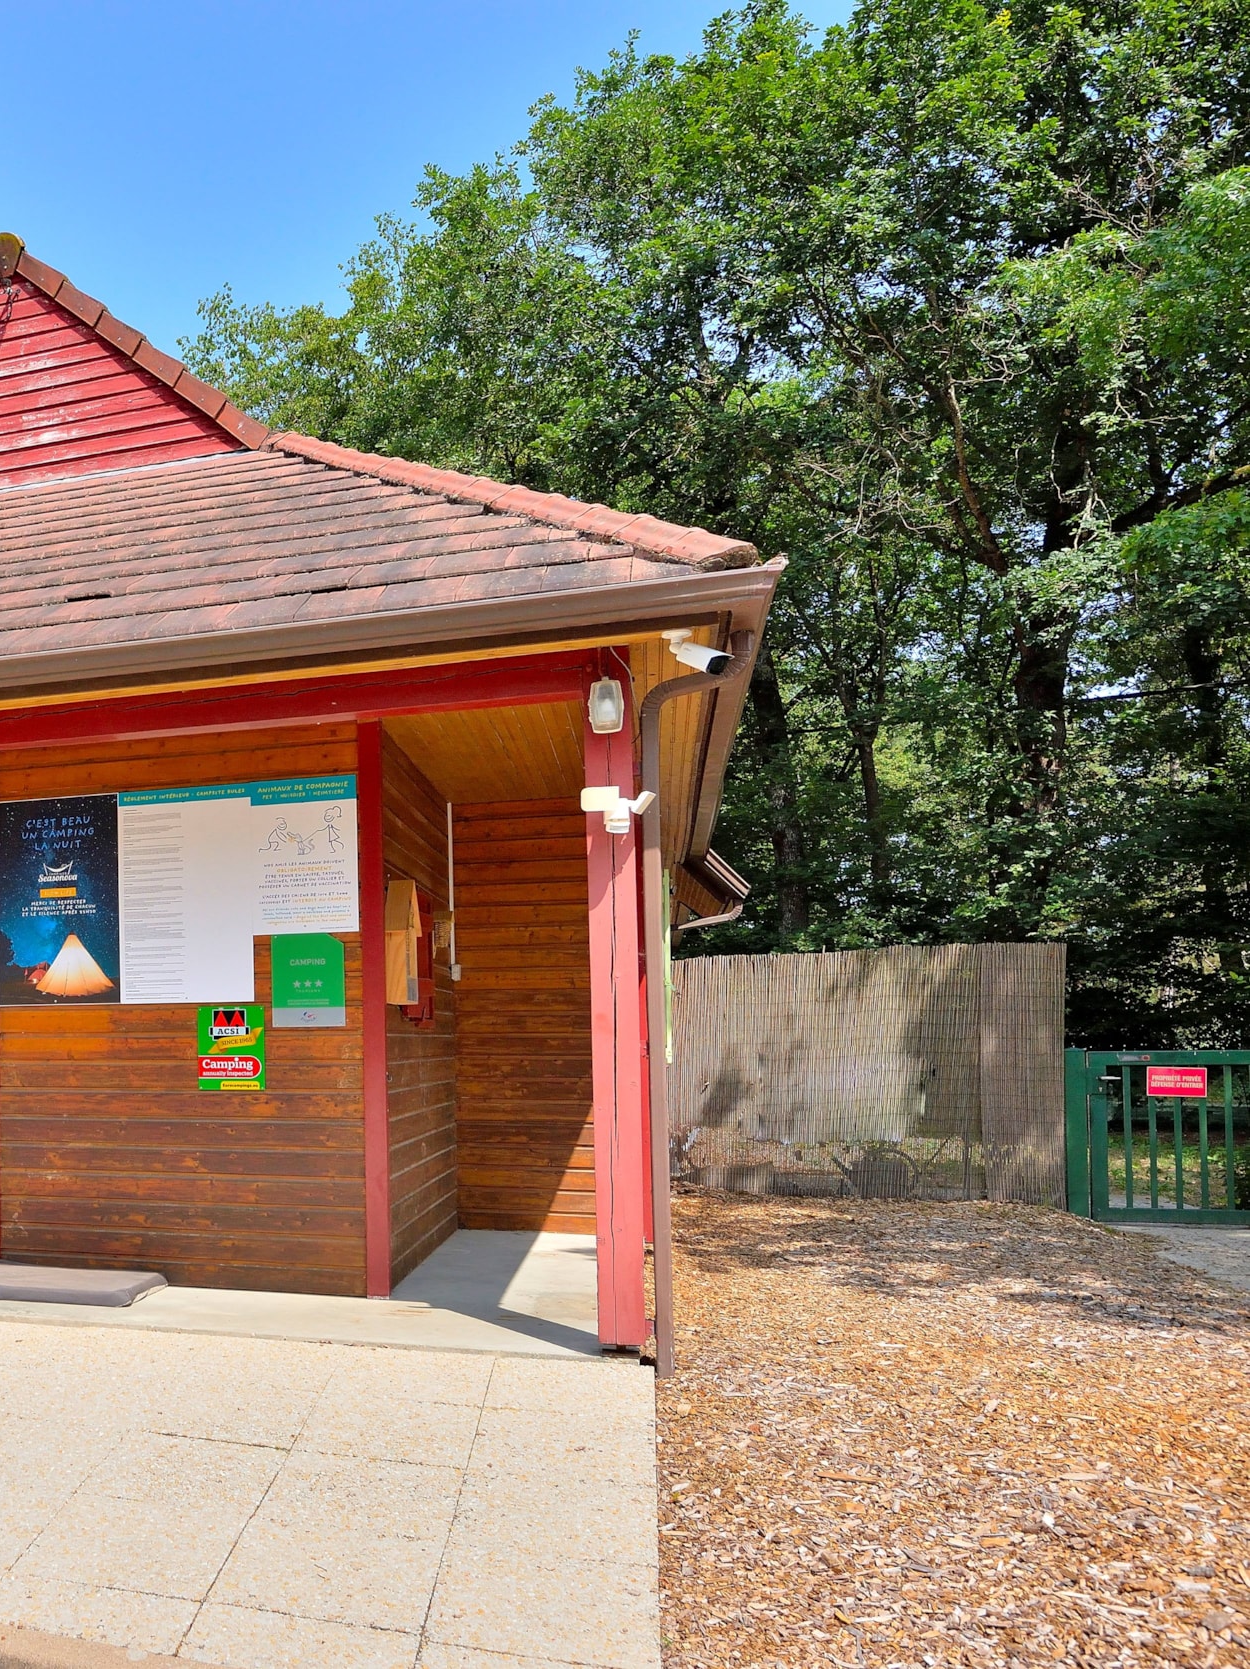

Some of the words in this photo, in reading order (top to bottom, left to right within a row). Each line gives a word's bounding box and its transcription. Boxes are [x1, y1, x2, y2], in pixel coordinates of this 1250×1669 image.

[306, 781, 349, 789] COMPAGNIE
[26, 818, 56, 828] C'EST
[62, 816, 90, 826] BEAU
[42, 827, 94, 838] CAMPING
[34, 842, 48, 850] LA
[53, 840, 81, 849] NUIT
[38, 874, 78, 882] Seasonova
[218, 1024, 239, 1034] ACSI
[202, 1057, 254, 1070] Camping
